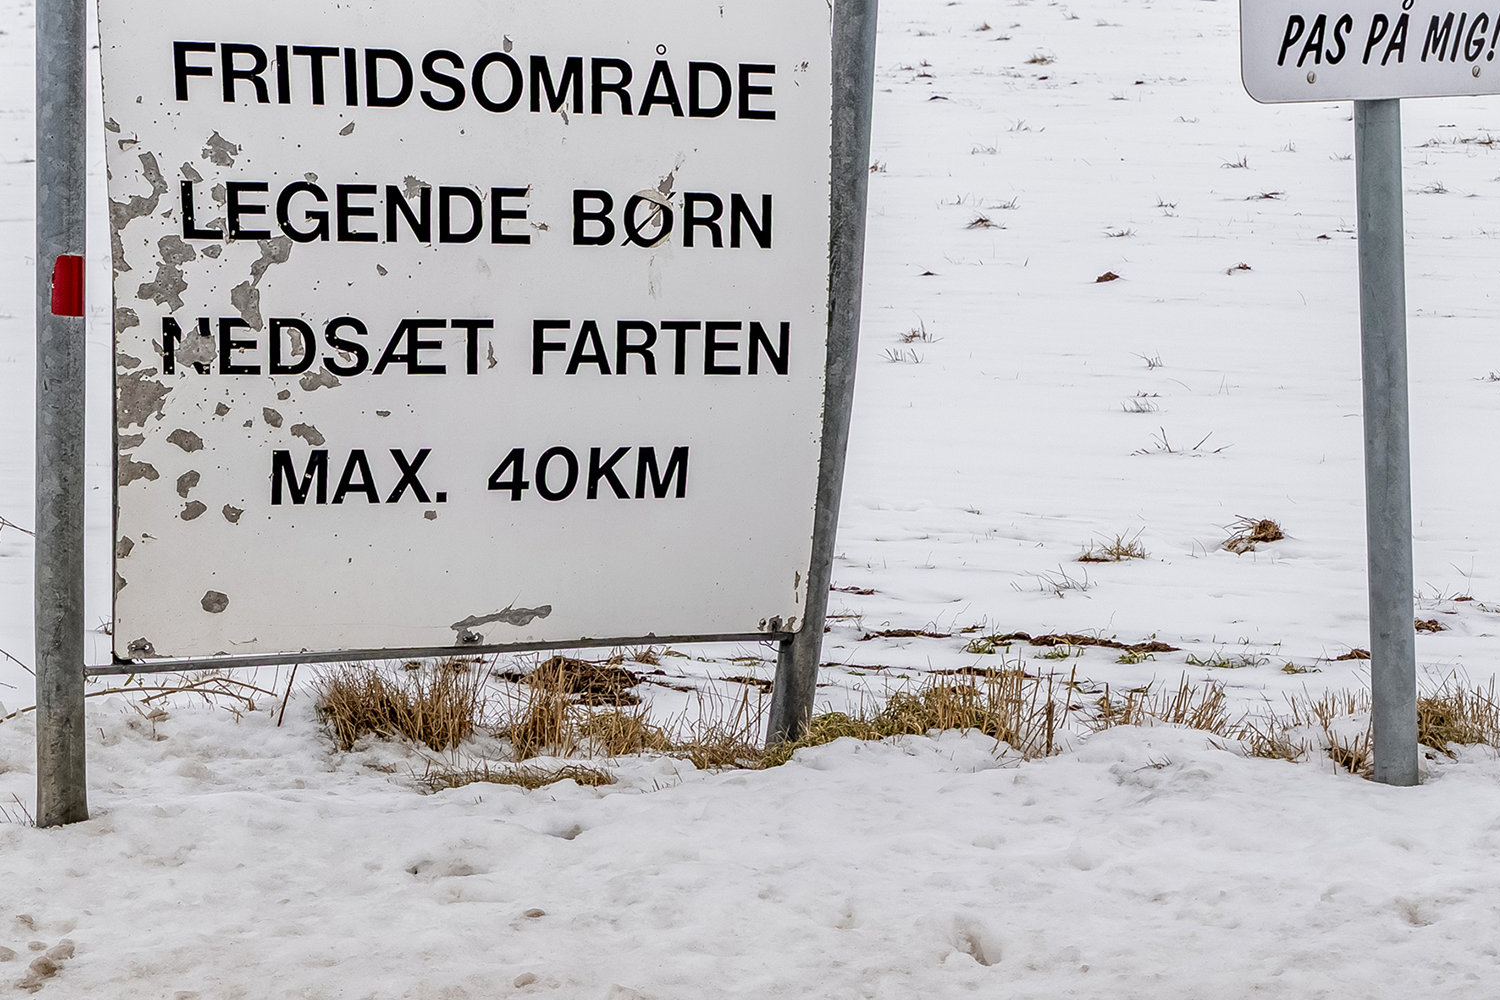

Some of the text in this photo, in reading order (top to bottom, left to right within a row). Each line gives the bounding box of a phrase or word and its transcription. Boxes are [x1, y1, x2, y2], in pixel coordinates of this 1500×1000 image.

[1277, 13, 1353, 67] PAS
[172, 41, 777, 121] FRITIDSOMRÅDE
[180, 180, 773, 249] LEGENDE BØRN
[531, 319, 791, 376] FARTEN
[270, 445, 690, 505] MAX. 40KM
